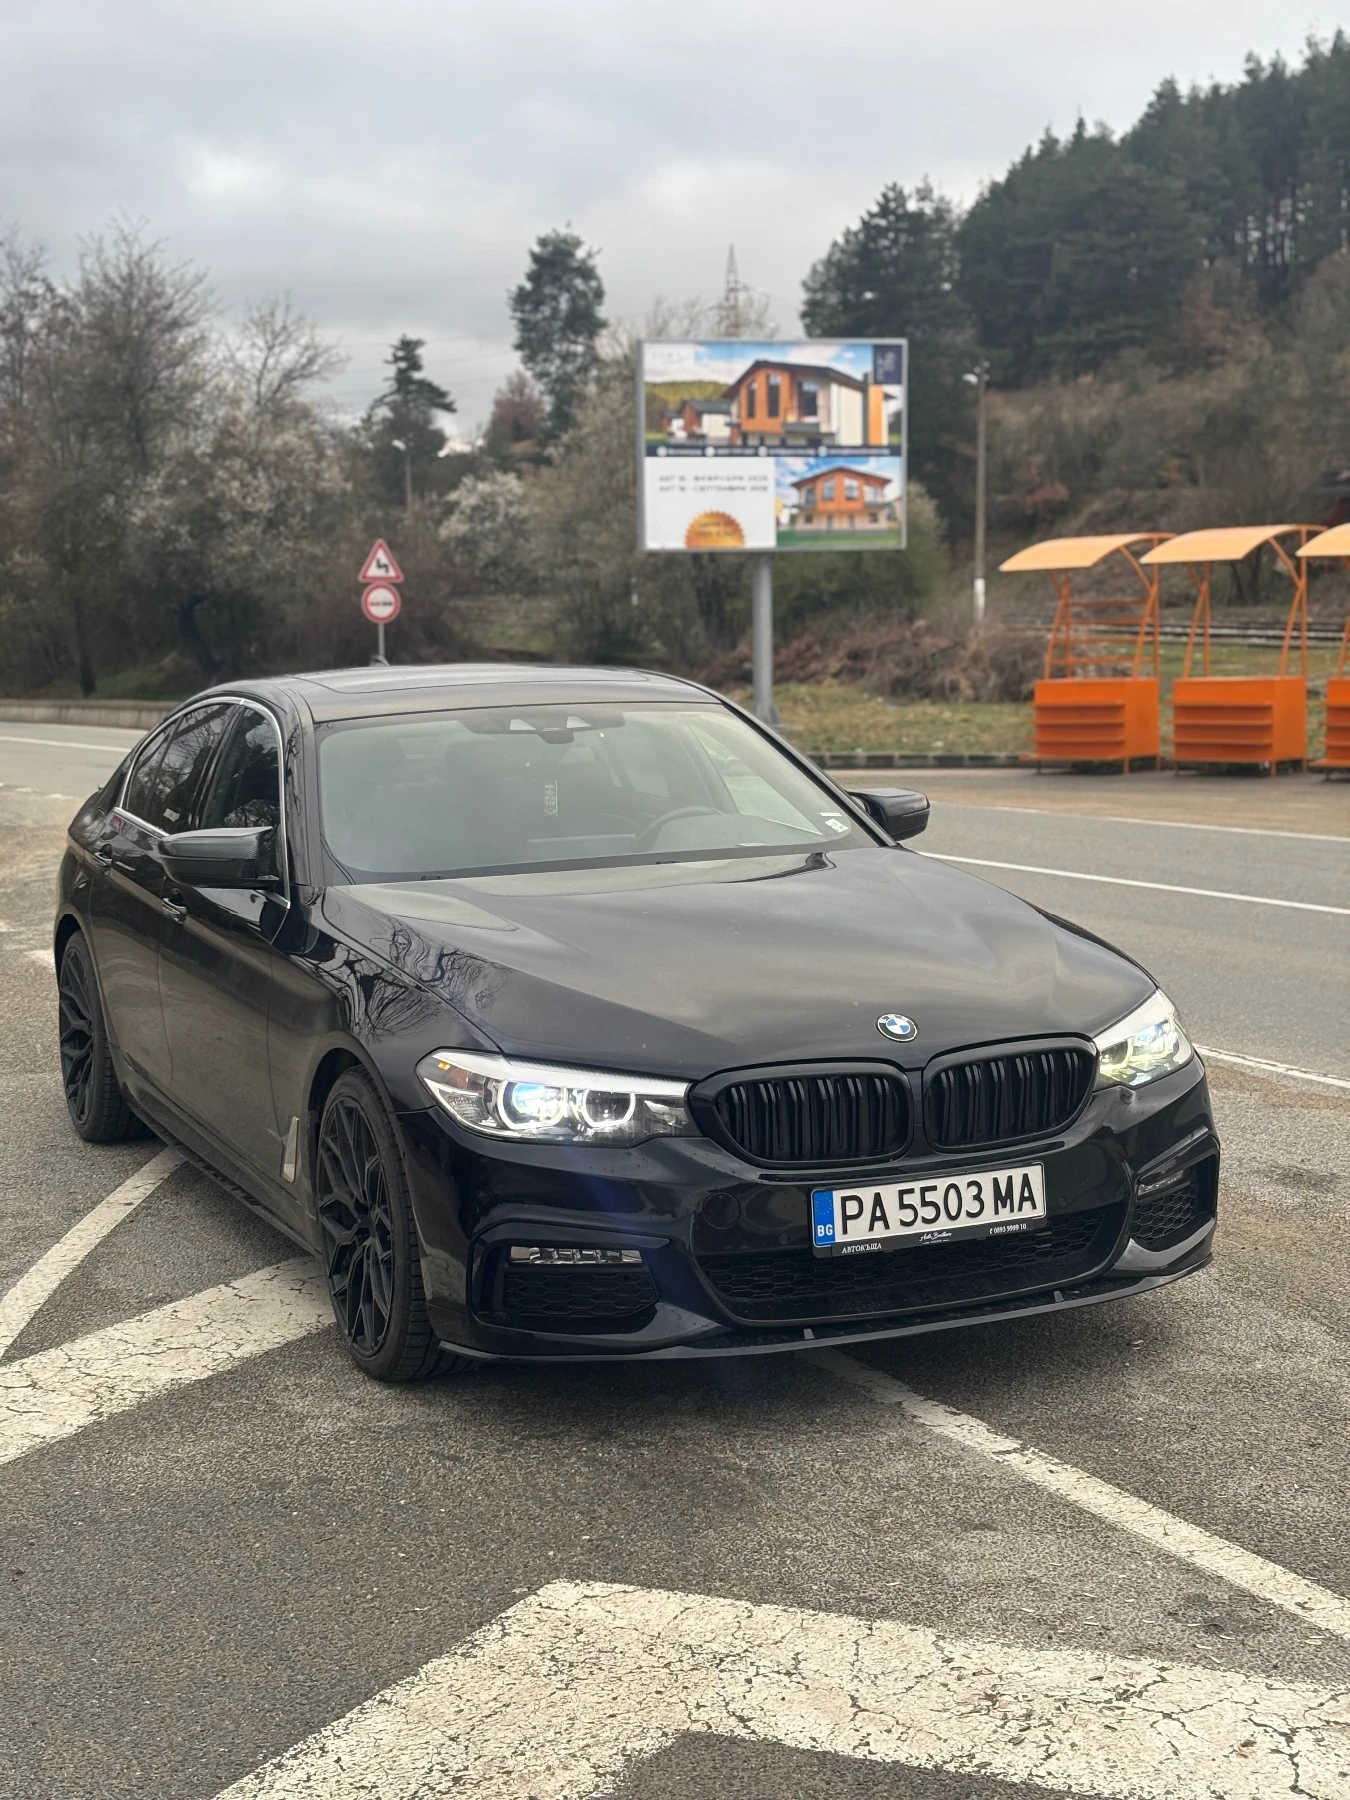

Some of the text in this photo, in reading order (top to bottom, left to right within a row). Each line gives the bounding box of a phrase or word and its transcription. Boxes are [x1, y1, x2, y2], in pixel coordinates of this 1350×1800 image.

[840, 1172, 1038, 1235] PA 5503 MA
[817, 1225, 833, 1237] BG
[841, 1242, 882, 1254] АВТОКЪЩА
